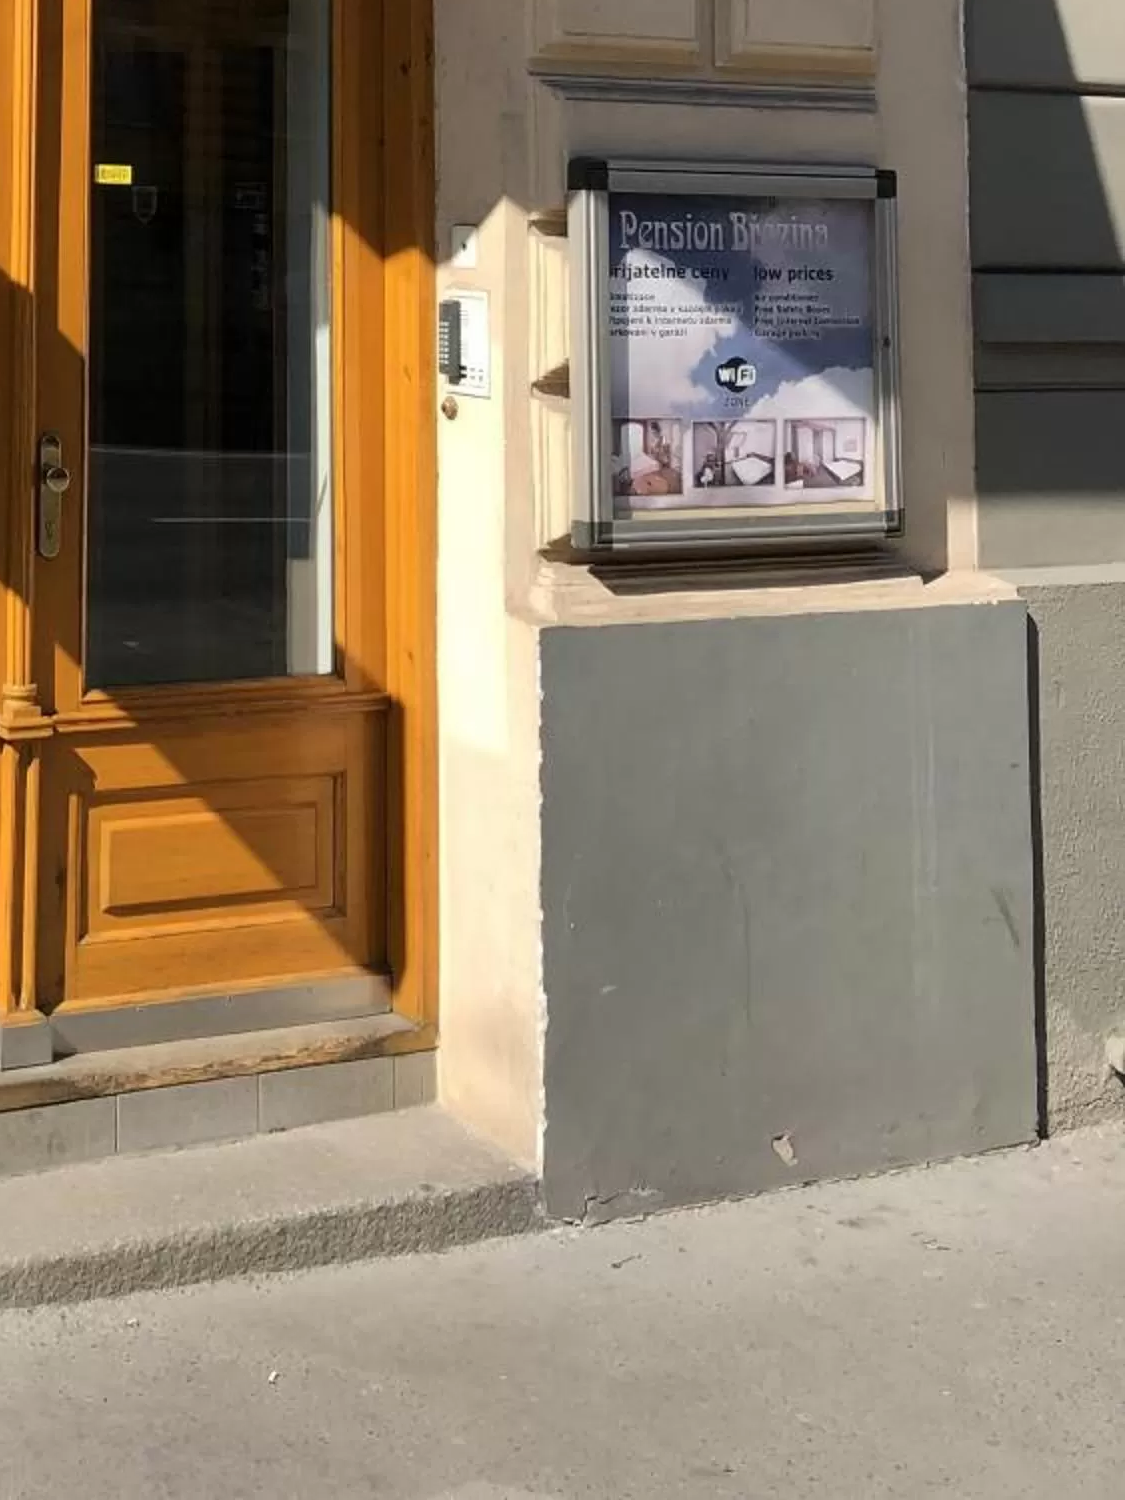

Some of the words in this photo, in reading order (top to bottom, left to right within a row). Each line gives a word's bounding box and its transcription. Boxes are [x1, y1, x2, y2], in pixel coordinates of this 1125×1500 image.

[619, 211, 724, 250] Pension
[691, 266, 730, 280] ceny
[755, 265, 782, 280] low
[787, 265, 833, 284] prices
